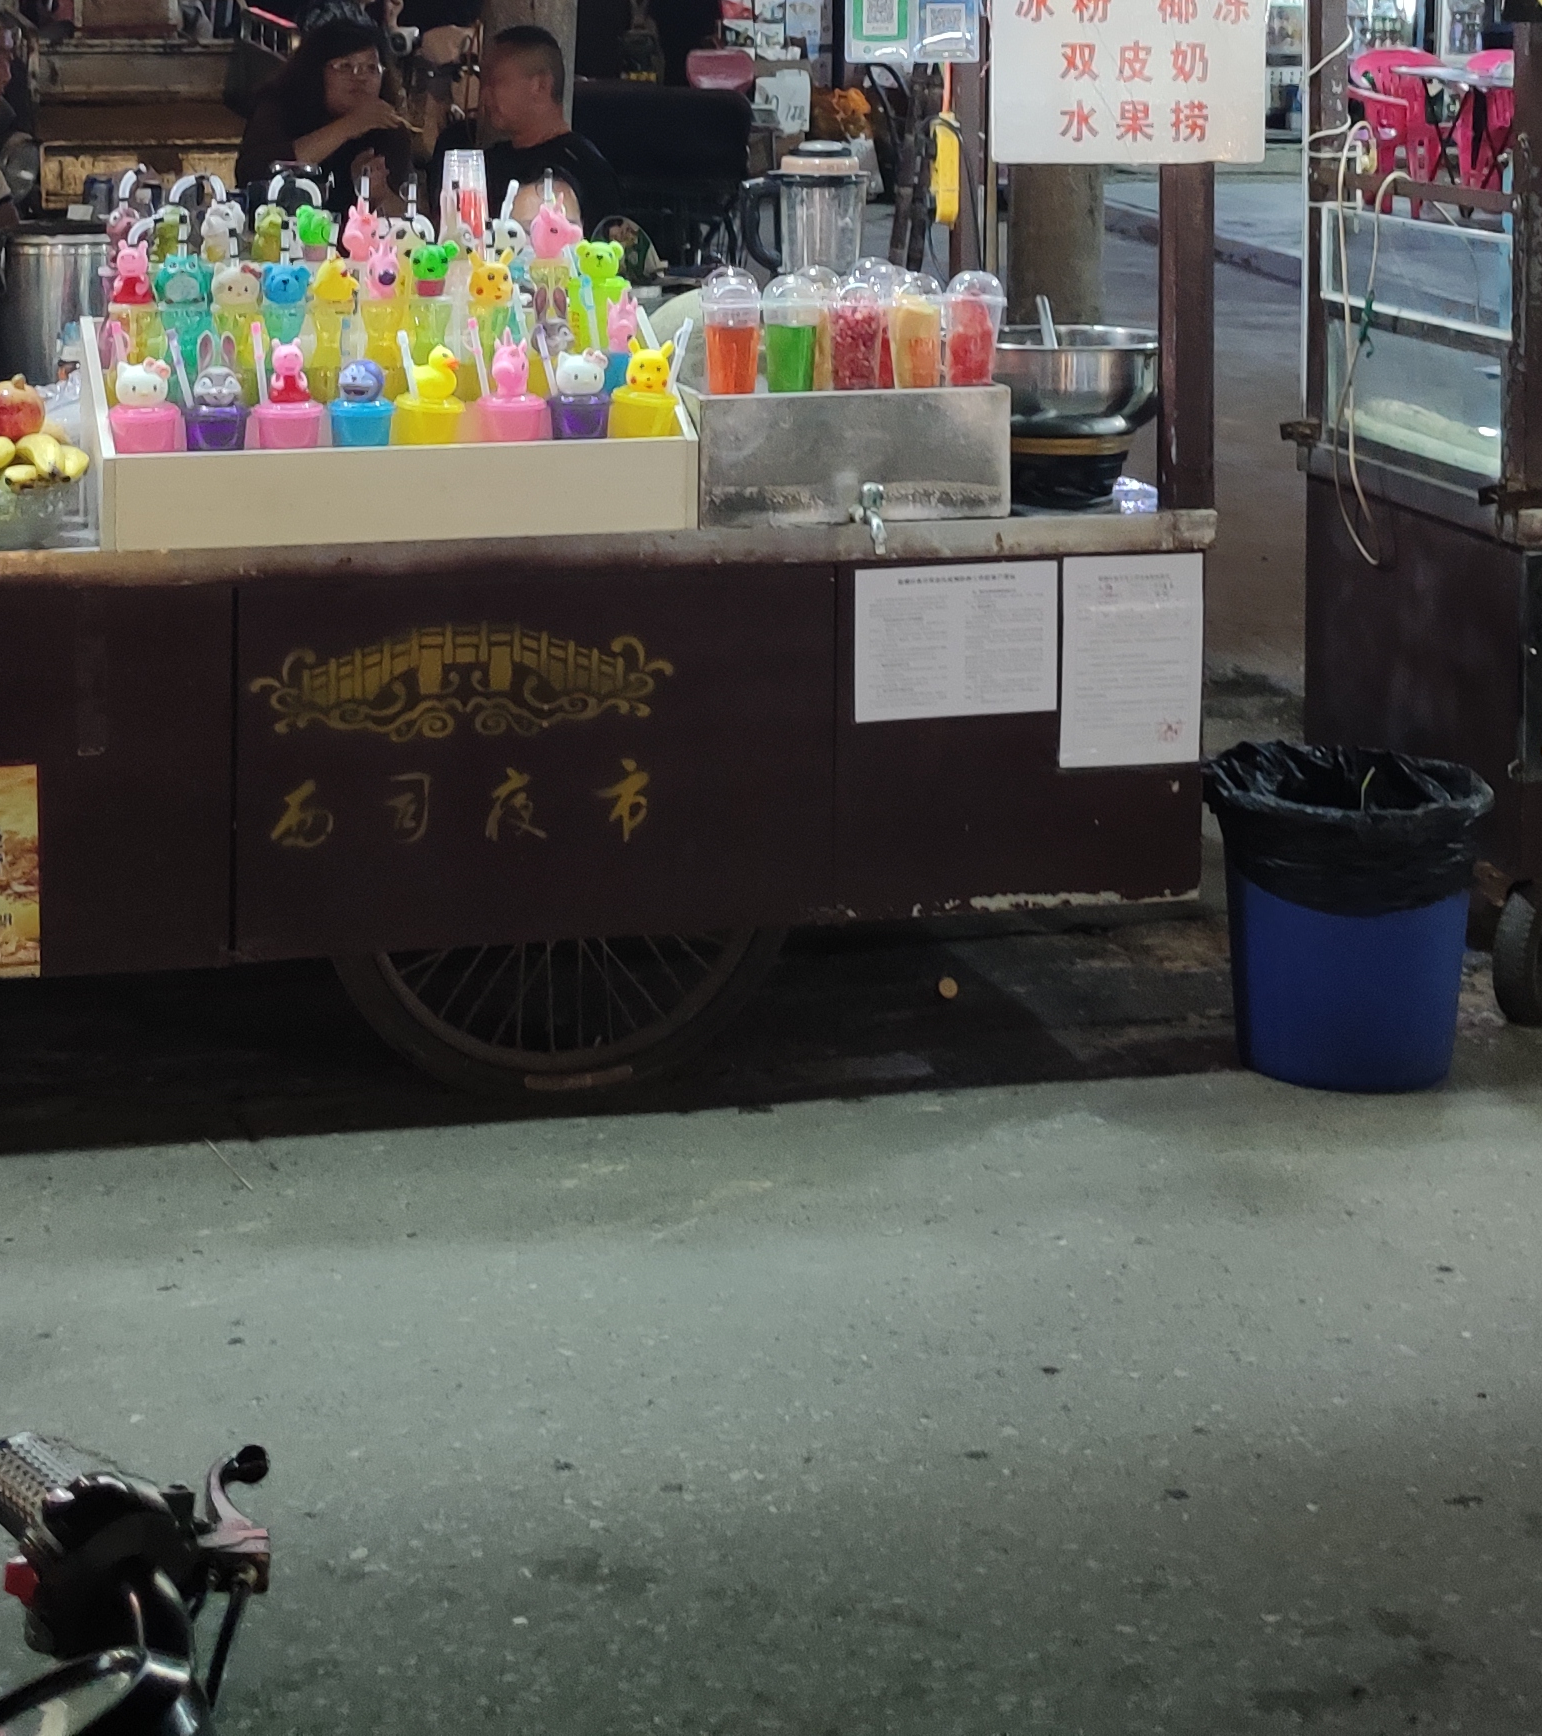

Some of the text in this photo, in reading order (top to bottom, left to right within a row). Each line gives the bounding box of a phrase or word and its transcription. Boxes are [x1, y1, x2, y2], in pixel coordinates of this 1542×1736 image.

[1060, 39, 1208, 83] 双皮奶
[1059, 99, 1209, 142] 水果捞
